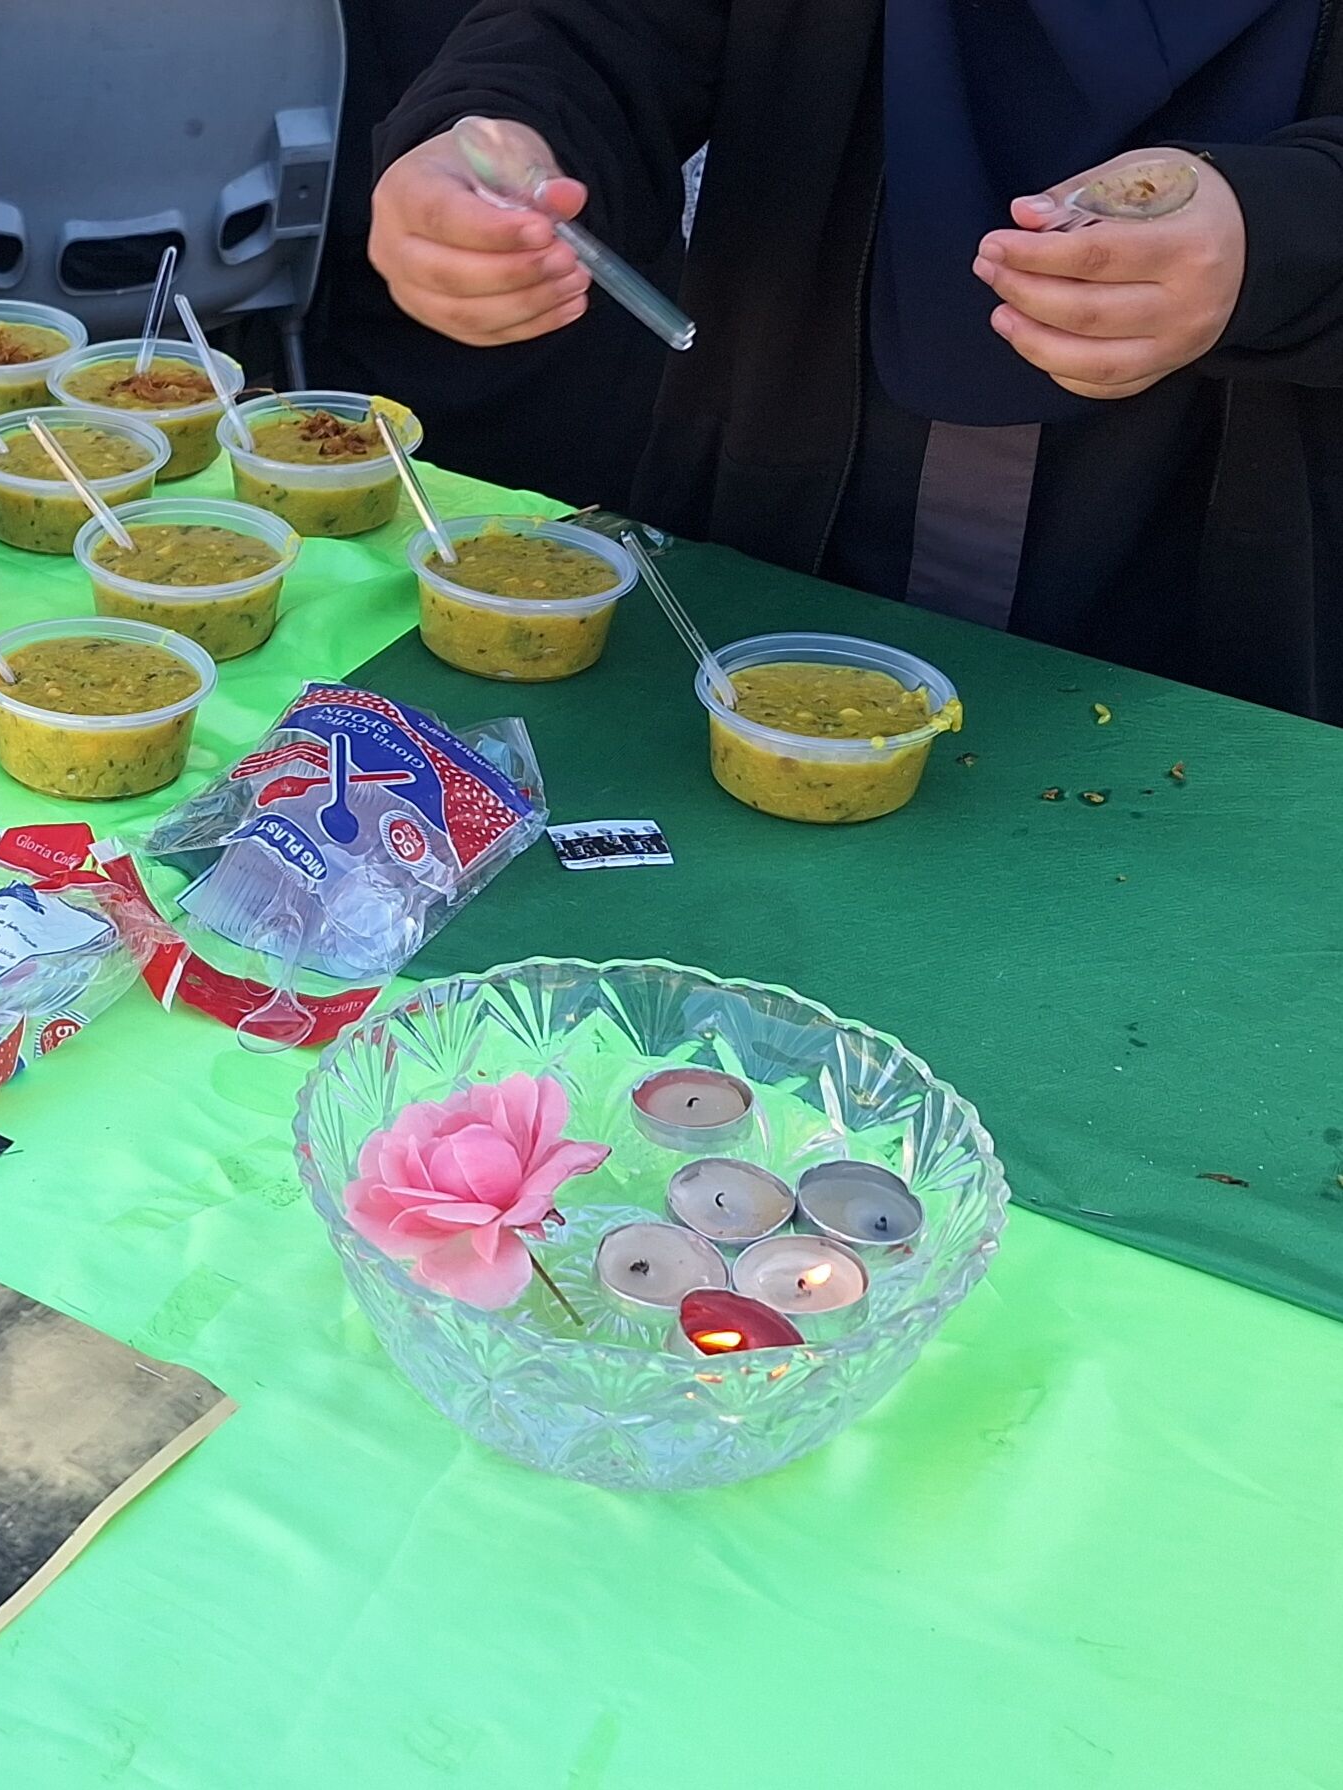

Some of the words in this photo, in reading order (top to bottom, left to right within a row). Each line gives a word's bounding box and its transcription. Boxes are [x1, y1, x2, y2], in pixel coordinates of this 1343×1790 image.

[311, 712, 370, 736] Coffee
[319, 705, 394, 734] SPOON
[372, 731, 426, 770] Gloria
[15, 834, 52, 859] Gloria
[390, 828, 416, 858] 50
[403, 822, 422, 850] PCS
[299, 851, 327, 880] MG
